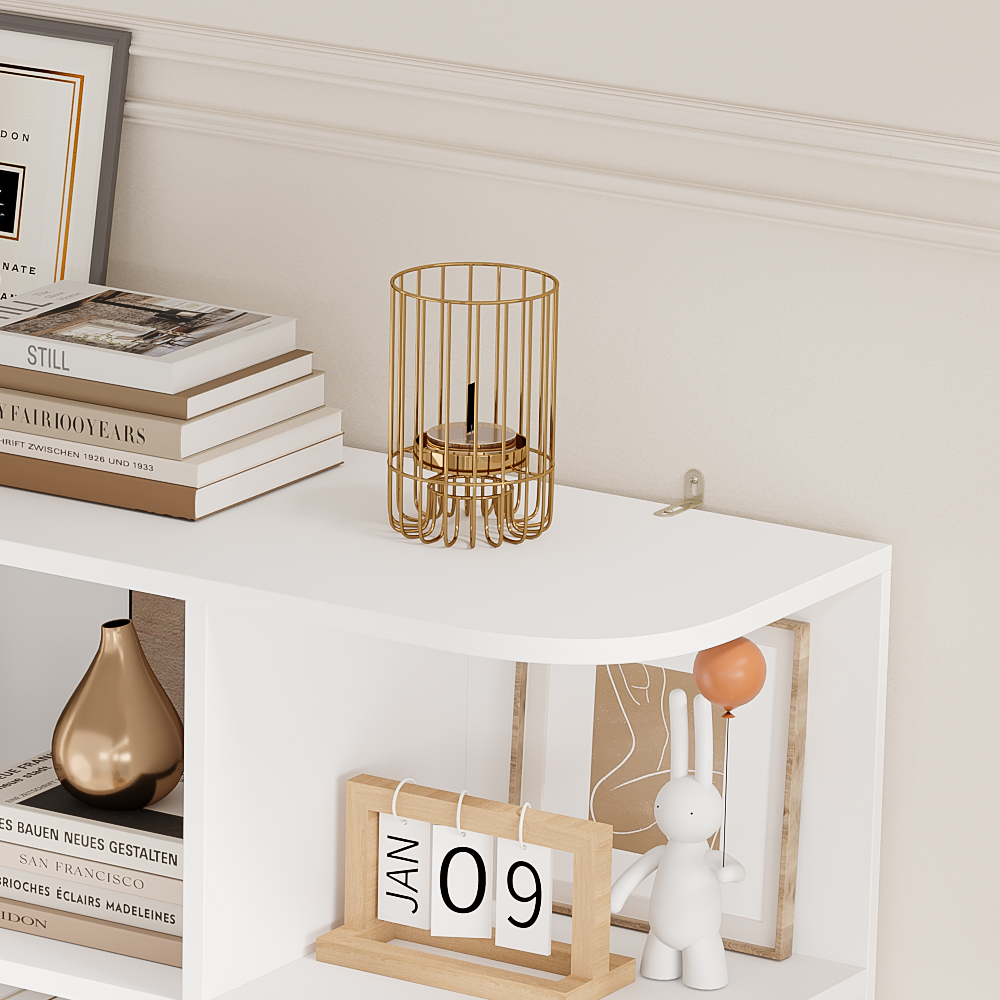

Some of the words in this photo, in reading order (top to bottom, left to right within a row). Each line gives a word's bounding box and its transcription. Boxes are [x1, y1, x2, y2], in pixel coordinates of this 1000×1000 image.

[27, 345, 70, 372] STILL
[28, 443, 80, 458] ZWISCHEN
[84, 453, 105, 463] 1926
[108, 458, 129, 467] UND
[133, 462, 154, 472] 1933
[17, 821, 59, 842] BAUEN
[64, 831, 105, 851] NEUES
[109, 841, 178, 867] GESTALTEN
[19, 853, 49, 869] SAN
[55, 861, 145, 890] FRANCISCO
[386, 834, 419, 915] JAN
[439, 846, 487, 915] 0
[56, 886, 101, 908] ÉCLAIRS
[106, 900, 176, 925] MADELEINES
[506, 860, 543, 929] 9
